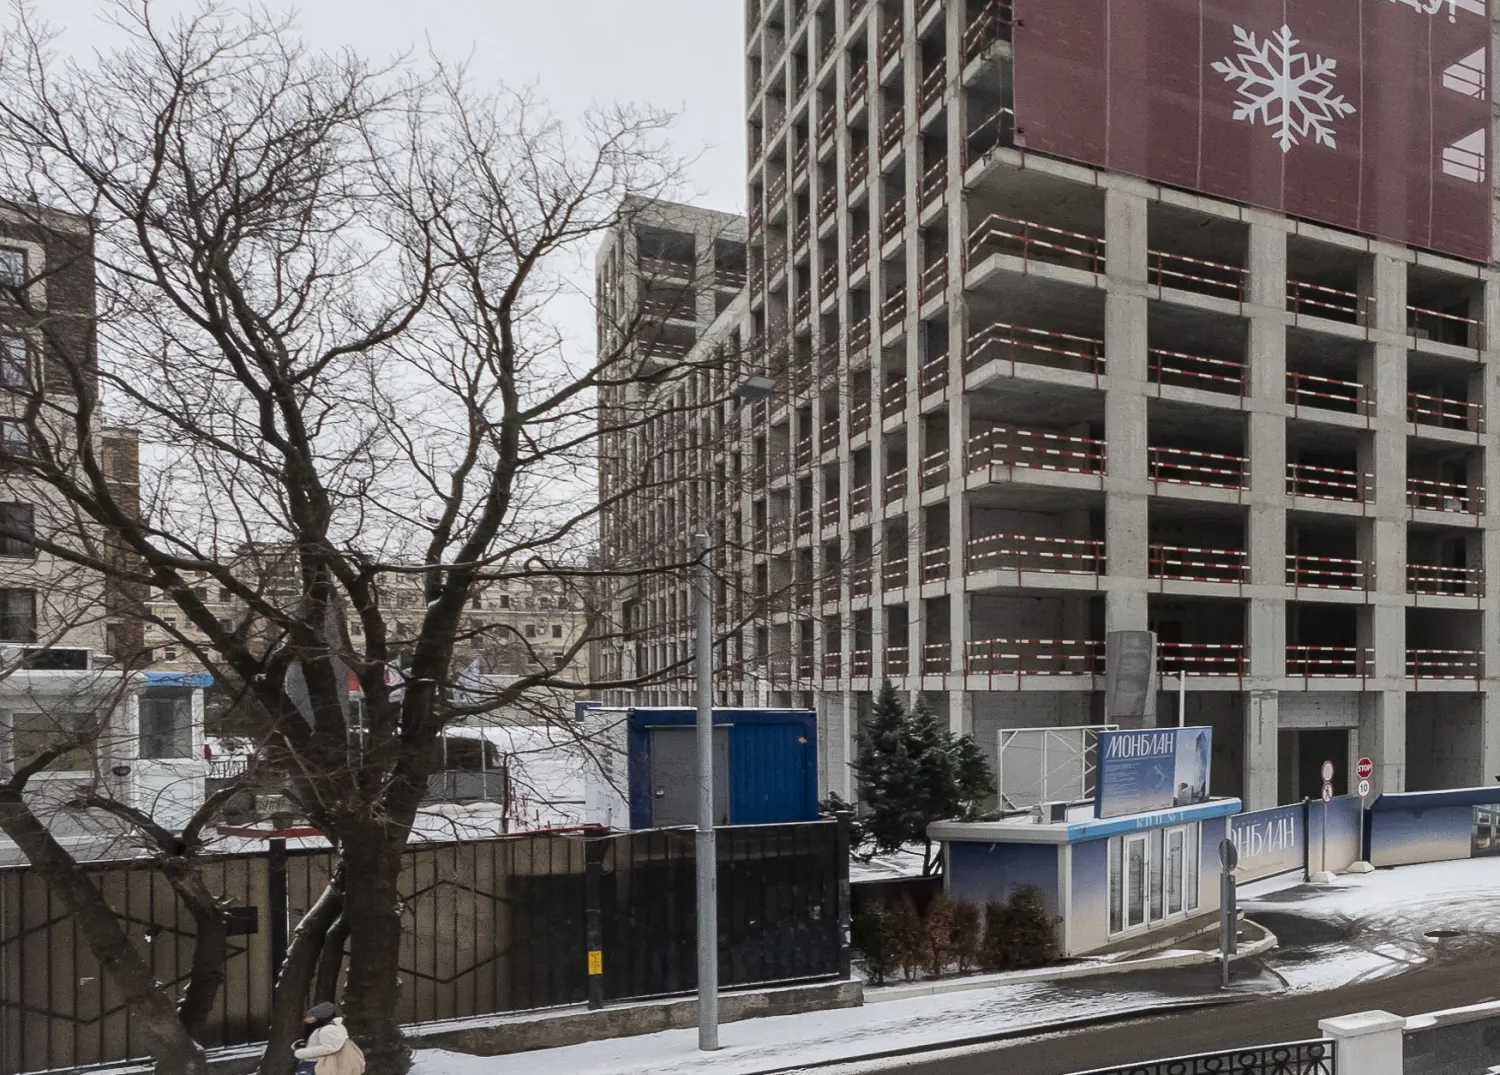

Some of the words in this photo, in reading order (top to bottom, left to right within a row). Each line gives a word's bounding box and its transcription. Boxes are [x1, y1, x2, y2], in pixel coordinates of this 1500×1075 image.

[1105, 732, 1174, 758] МОНБЛАН
[1358, 764, 1371, 772] STOP
[1360, 783, 1368, 792] 10
